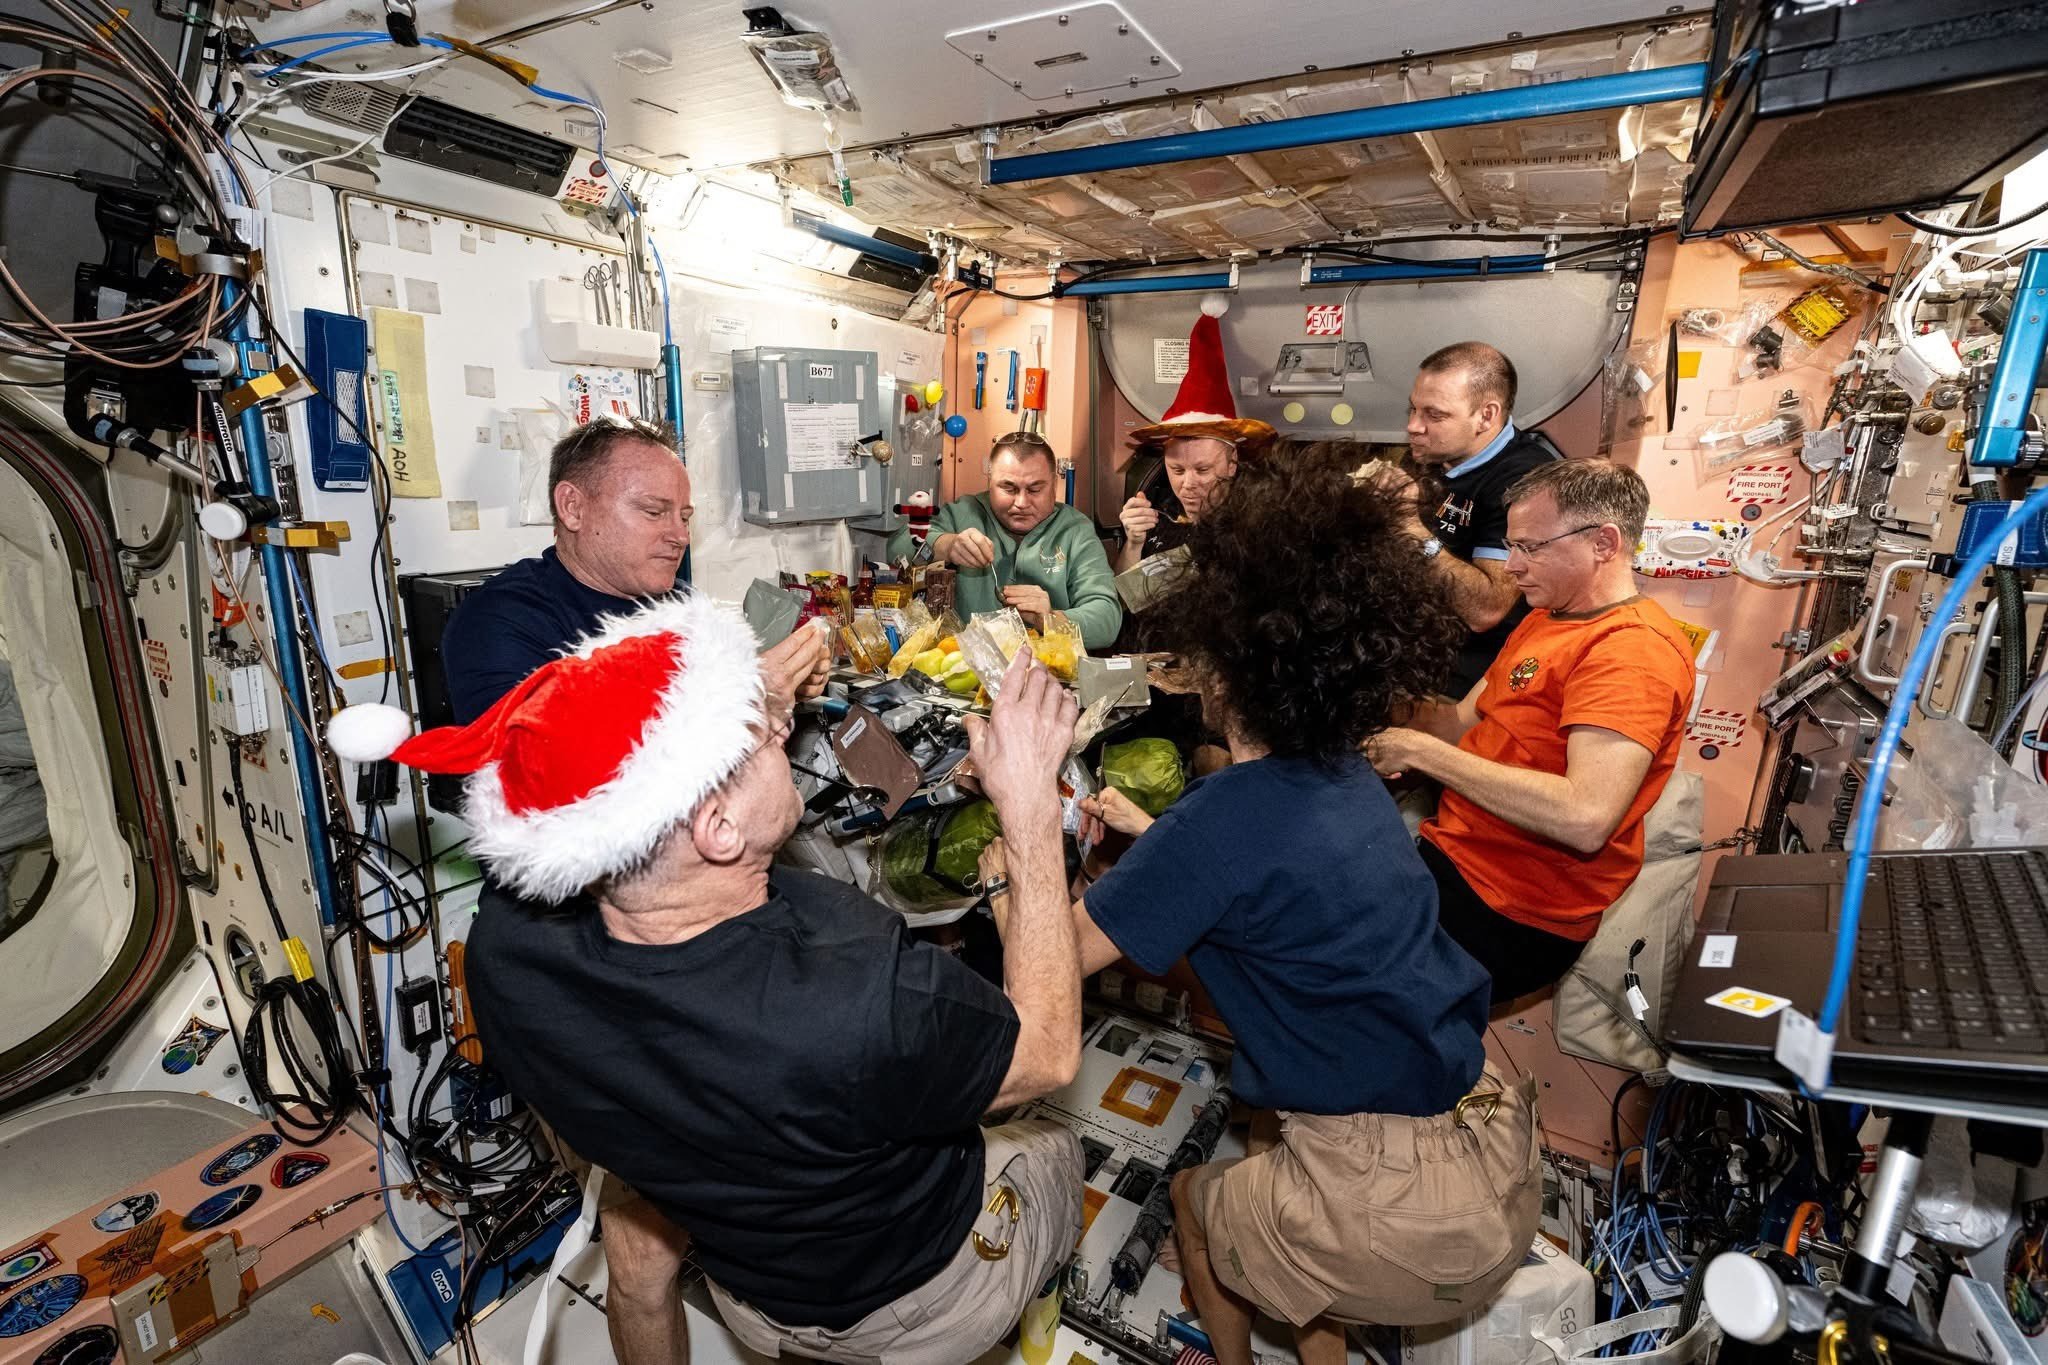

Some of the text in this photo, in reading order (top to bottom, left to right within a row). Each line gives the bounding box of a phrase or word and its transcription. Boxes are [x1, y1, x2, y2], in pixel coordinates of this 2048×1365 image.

[1312, 313, 1337, 328] EXIT
[811, 366, 833, 376] B677
[214, 405, 233, 453] Manfrotto
[392, 447, 411, 482] AOH
[1758, 481, 1782, 489] PORT
[1440, 520, 1456, 534] 72
[1695, 722, 1737, 733] FIRE PORT
